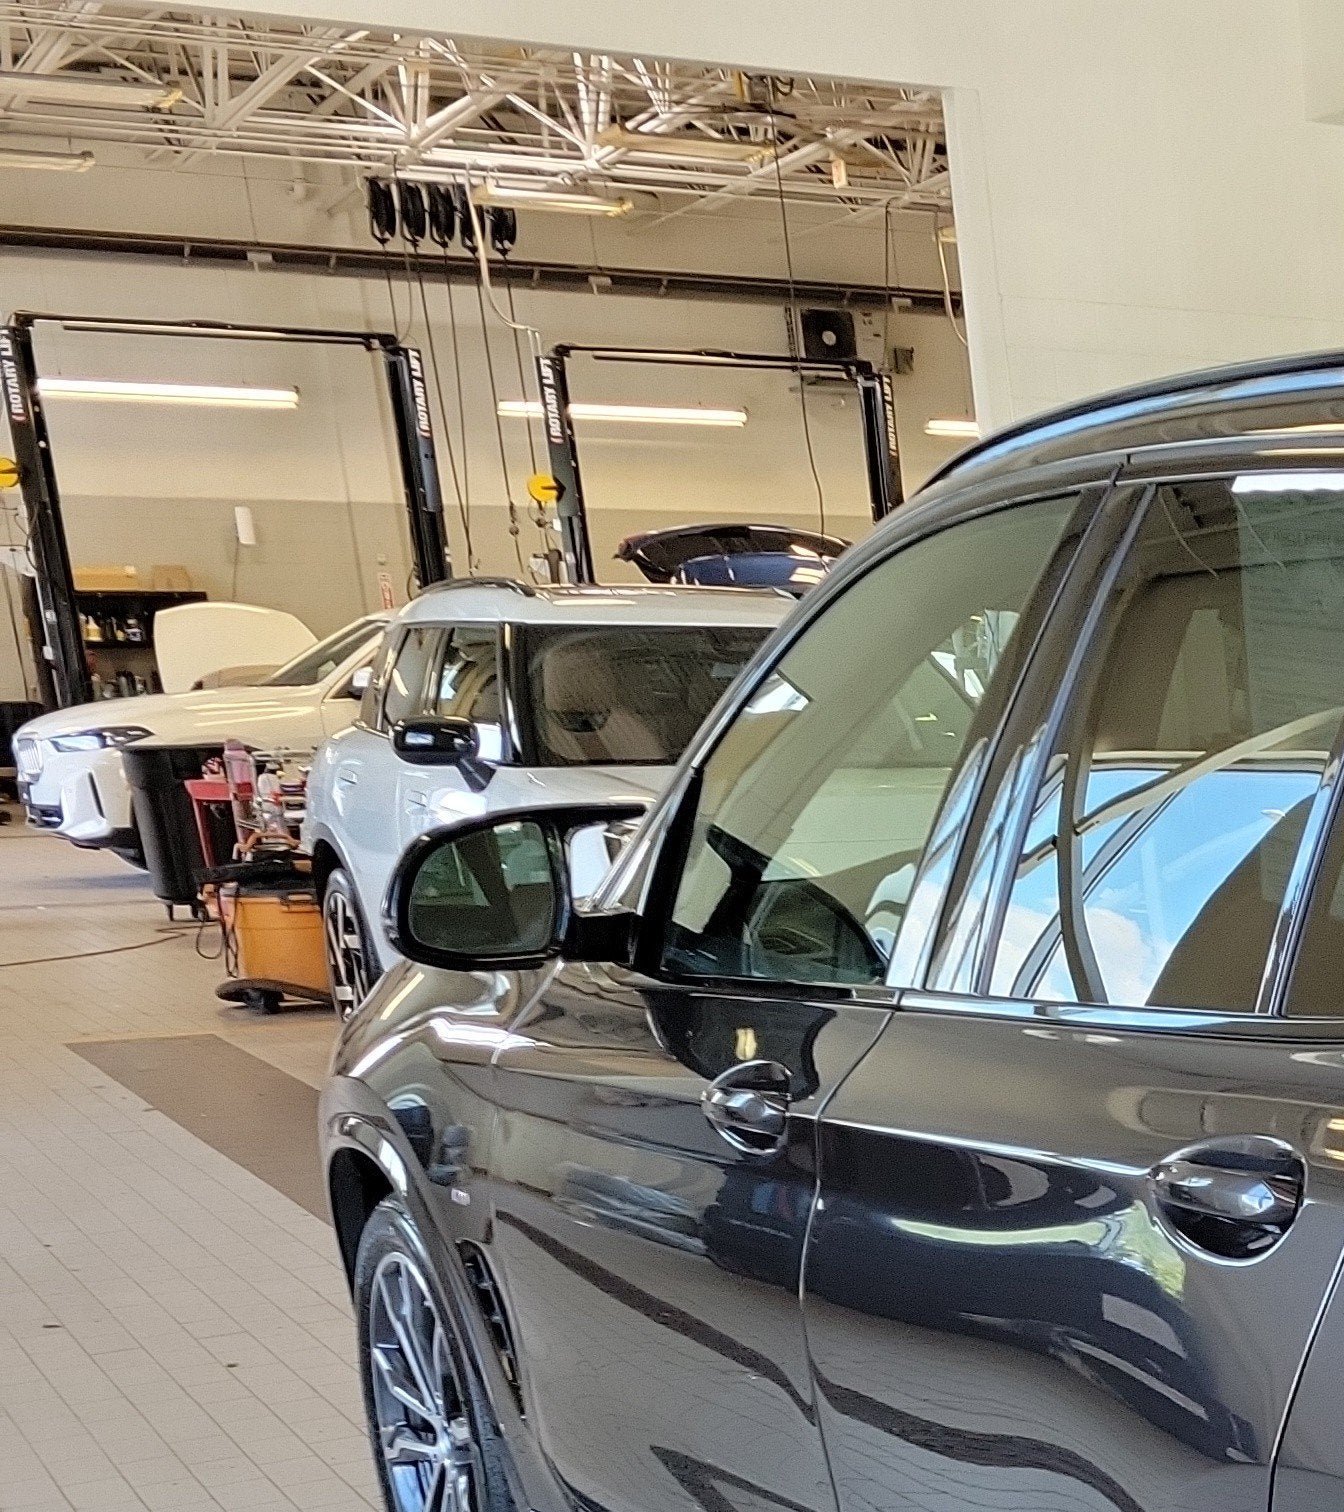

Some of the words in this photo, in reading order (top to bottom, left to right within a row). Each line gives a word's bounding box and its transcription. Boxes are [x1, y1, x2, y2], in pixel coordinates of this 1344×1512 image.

[3, 359, 25, 414] ROTARY
[407, 348, 423, 378] LIFT
[539, 357, 555, 385] LIFT
[412, 378, 431, 431] ROTARY
[542, 386, 563, 437] ROTARY
[882, 375, 893, 401] LIFT
[884, 402, 897, 451] ROTARY
